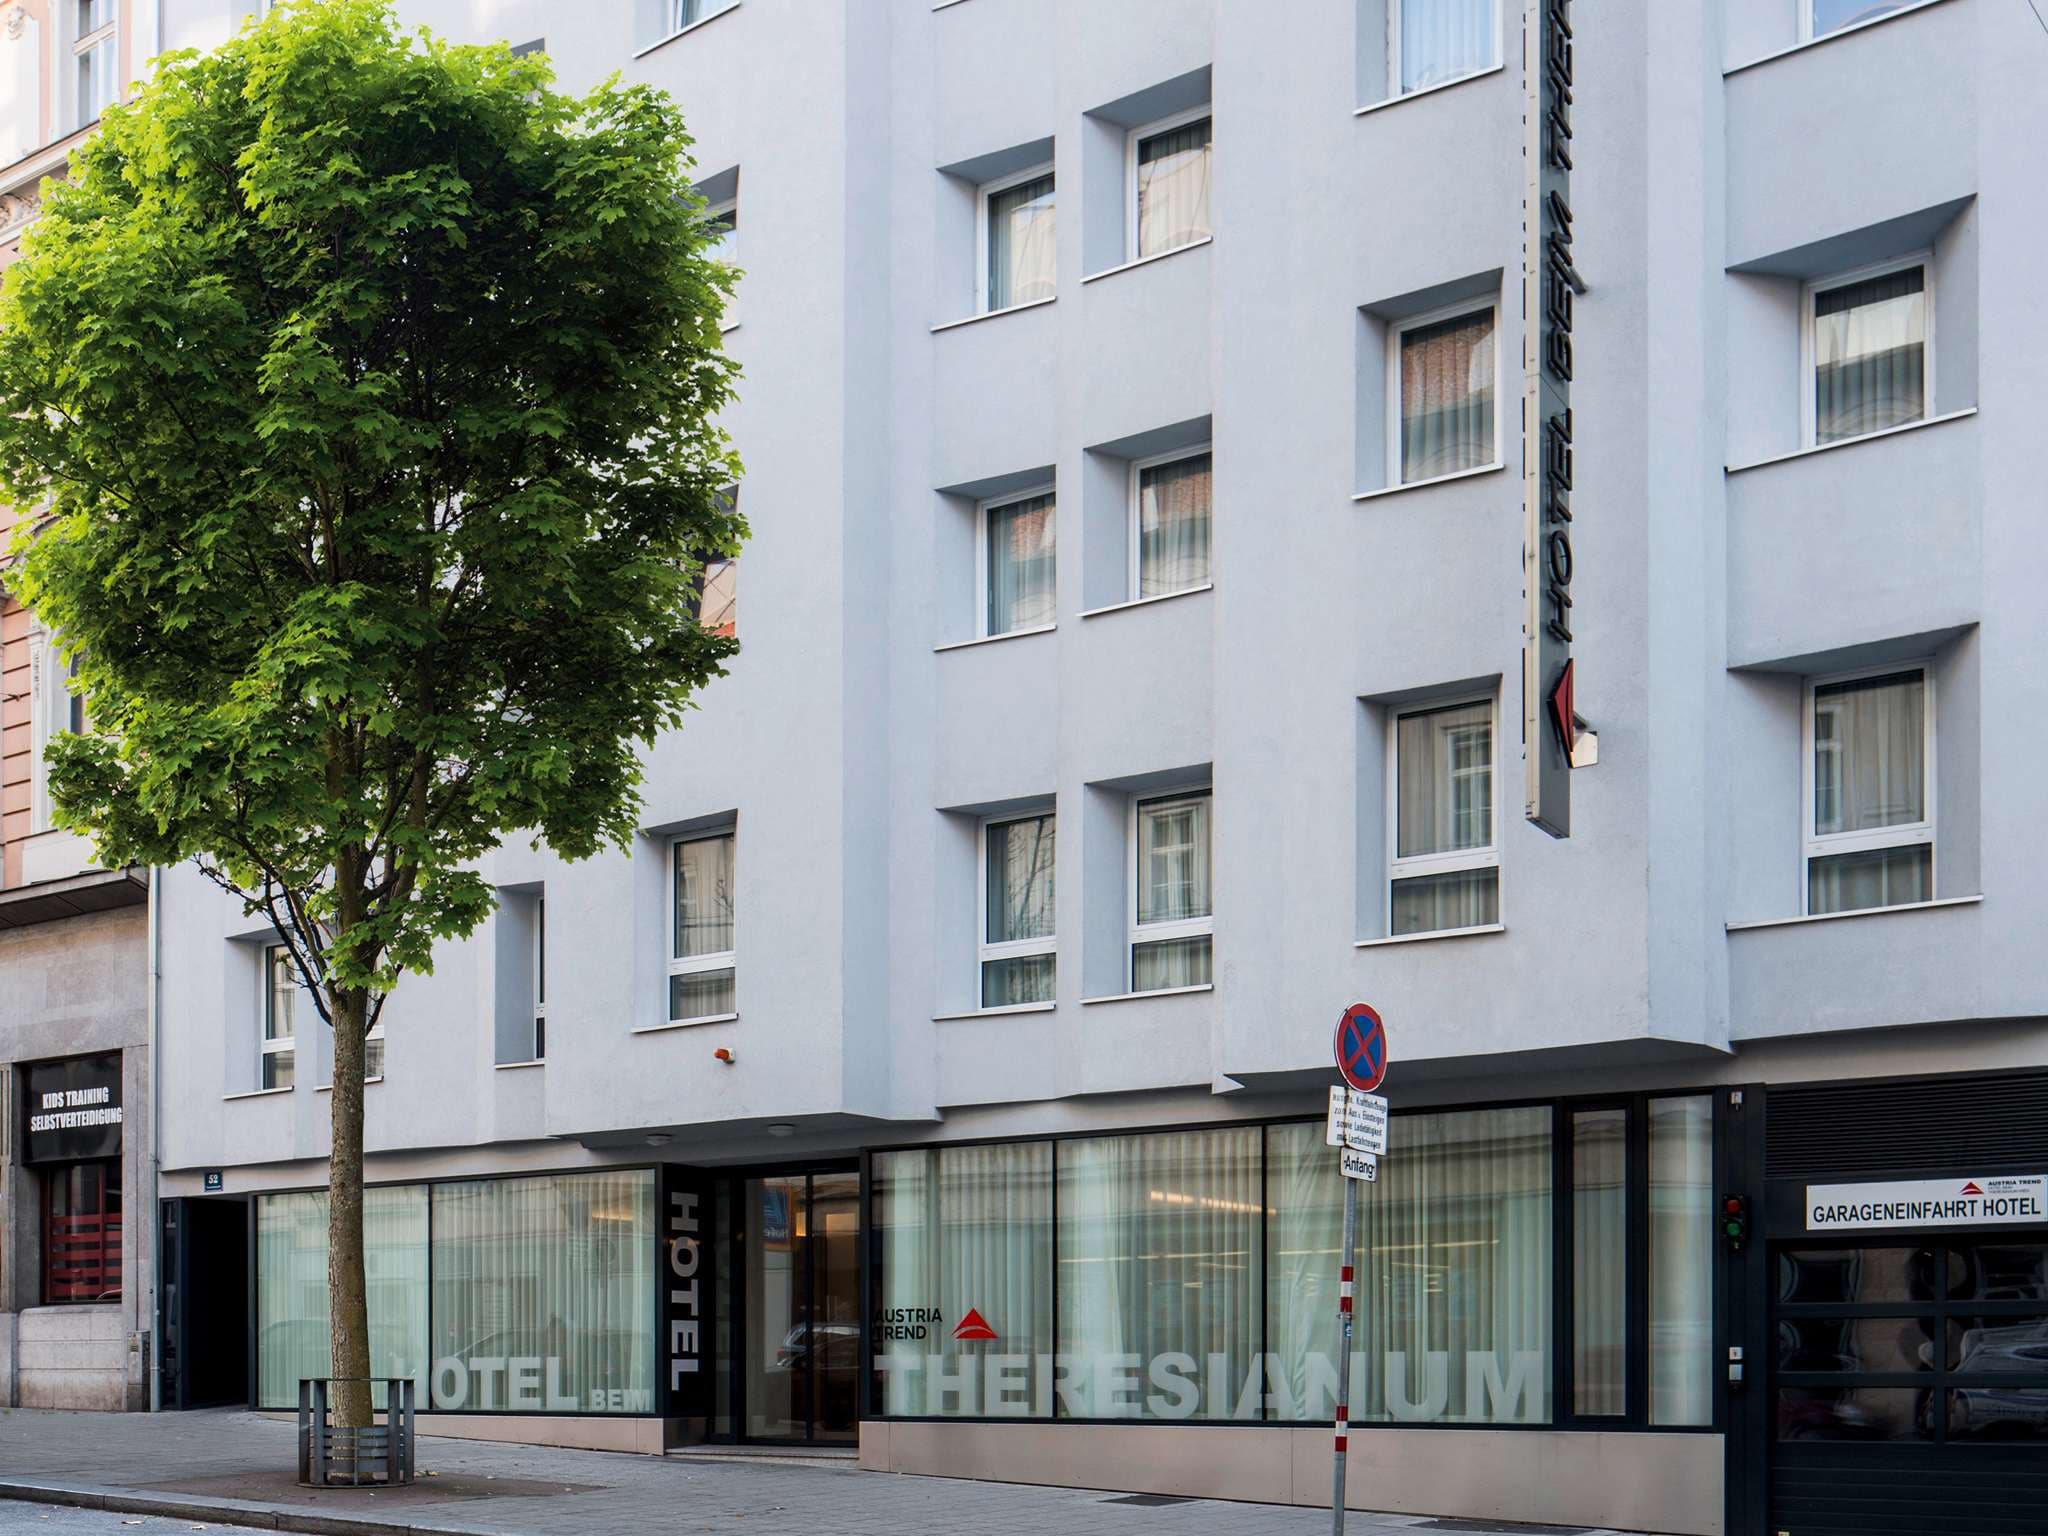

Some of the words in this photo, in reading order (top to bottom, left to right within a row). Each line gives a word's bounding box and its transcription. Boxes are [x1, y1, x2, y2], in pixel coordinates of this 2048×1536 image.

[1548, 408, 1572, 643] HOTEL
[42, 1091, 65, 1109] KIDS
[66, 1086, 109, 1107] TRAINING
[31, 1107, 122, 1132] SELBSTVERTEIDIGUNG
[208, 1174, 219, 1184] 52
[1813, 1200, 1979, 1223] GARAGENEINFAHRT
[1983, 1197, 2041, 1217] HOTEL
[671, 1191, 699, 1391] HOTEL
[874, 1308, 943, 1323] AUSTRIA
[874, 1326, 927, 1339] TREND
[874, 1350, 1544, 1424] THERESIANUM
[592, 1389, 650, 1411] BEIM
